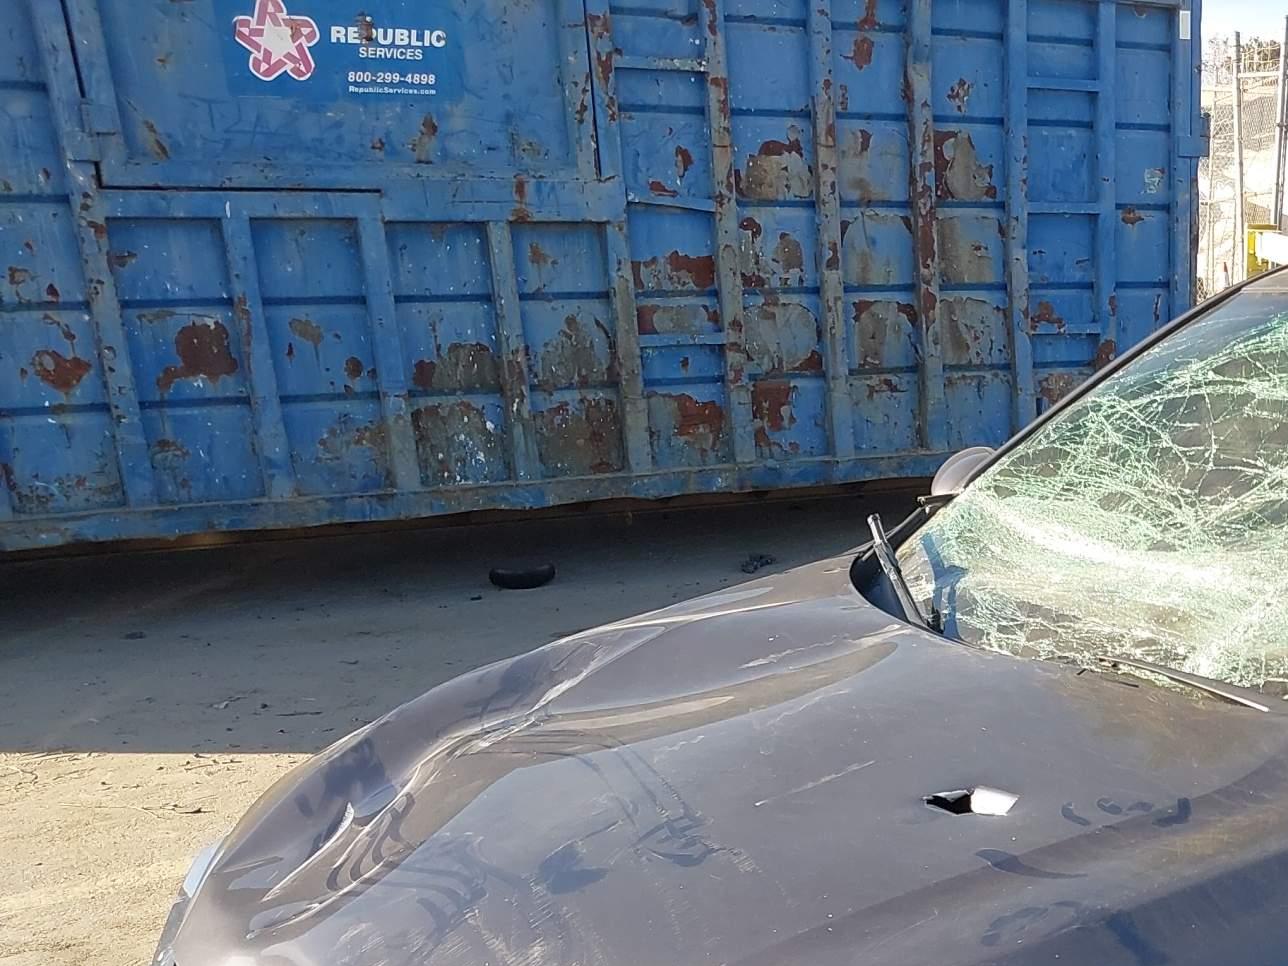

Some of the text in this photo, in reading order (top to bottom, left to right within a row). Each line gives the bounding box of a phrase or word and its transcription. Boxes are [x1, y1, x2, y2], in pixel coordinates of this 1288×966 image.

[358, 46, 424, 60] SERVICES
[347, 71, 437, 85] 800-299-4898
[348, 85, 437, 95] RepublicServices.com
